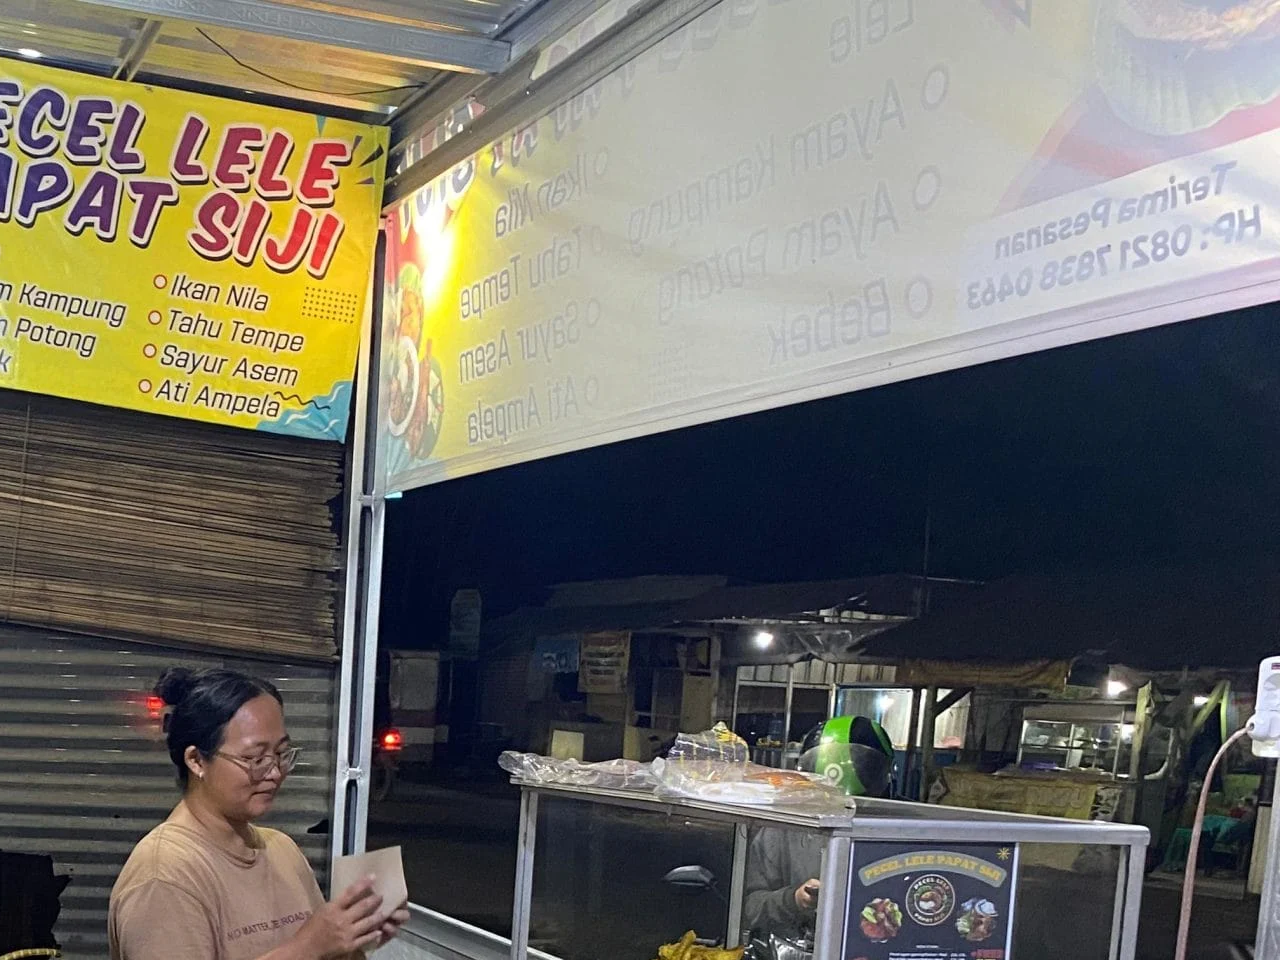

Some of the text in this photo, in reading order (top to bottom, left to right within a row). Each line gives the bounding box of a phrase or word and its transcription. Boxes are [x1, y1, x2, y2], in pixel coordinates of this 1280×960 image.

[169, 112, 352, 208] LELE
[187, 191, 346, 279] SIJI
[19, 283, 128, 330] Kampung
[171, 273, 270, 313] Ikan Nila
[14, 317, 97, 360] Potong
[166, 309, 304, 356] Tahu Tempe
[160, 343, 299, 387] Sayur Asem
[154, 378, 281, 422] Ati Ampela
